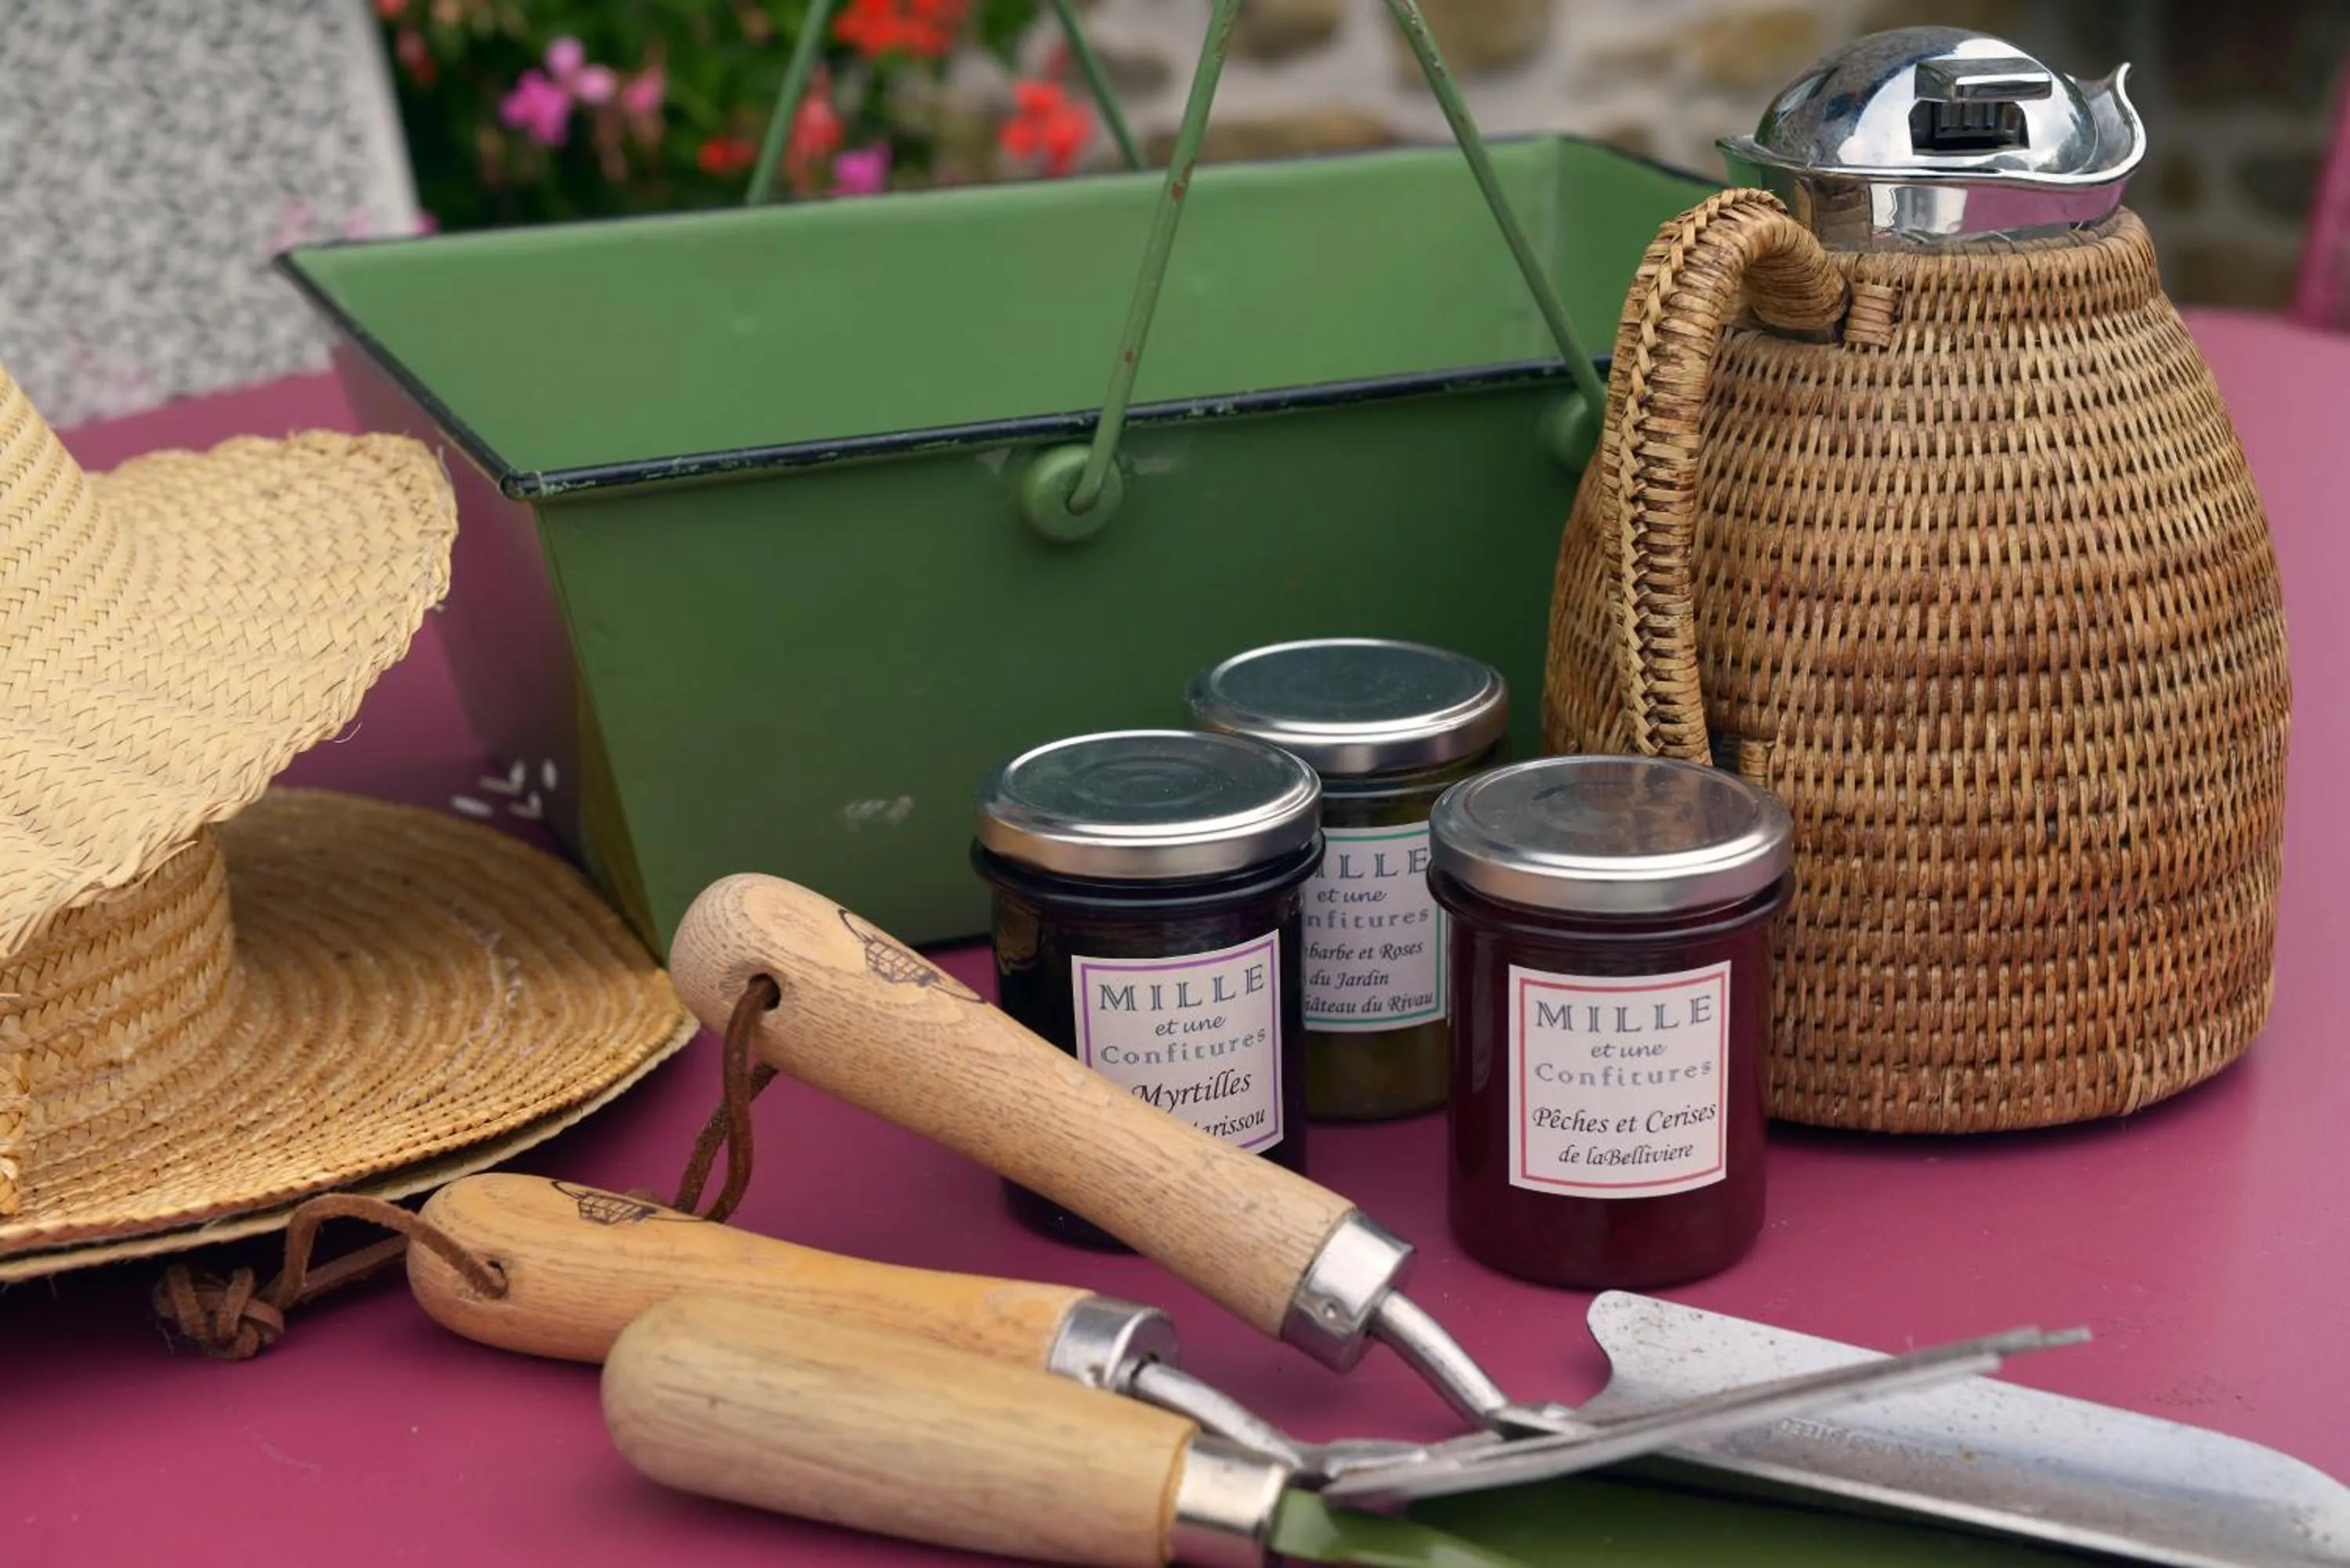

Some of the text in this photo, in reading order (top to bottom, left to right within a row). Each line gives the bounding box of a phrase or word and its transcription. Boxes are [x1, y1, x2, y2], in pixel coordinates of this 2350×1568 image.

[1314, 847, 1428, 879] ILLE
[1317, 888, 1387, 902] et une
[1303, 909, 1430, 929] nfitures
[1303, 941, 1423, 961] barbe et Roses
[1099, 963, 1264, 1011] MILLE
[1309, 970, 1390, 990] du Jardin
[1361, 995, 1383, 1013] du
[1386, 992, 1434, 1013] Rivau
[1535, 995, 1712, 1033] MILLE
[1155, 1016, 1227, 1036] et une
[1101, 1028, 1266, 1065] Confitures
[1591, 1043, 1668, 1058] et une
[1534, 1060, 1713, 1087] Confitures
[1131, 1068, 1252, 1114] Myrtilles
[1532, 1104, 1717, 1134] Pêches et Cerises
[1558, 1144, 1581, 1165] de
